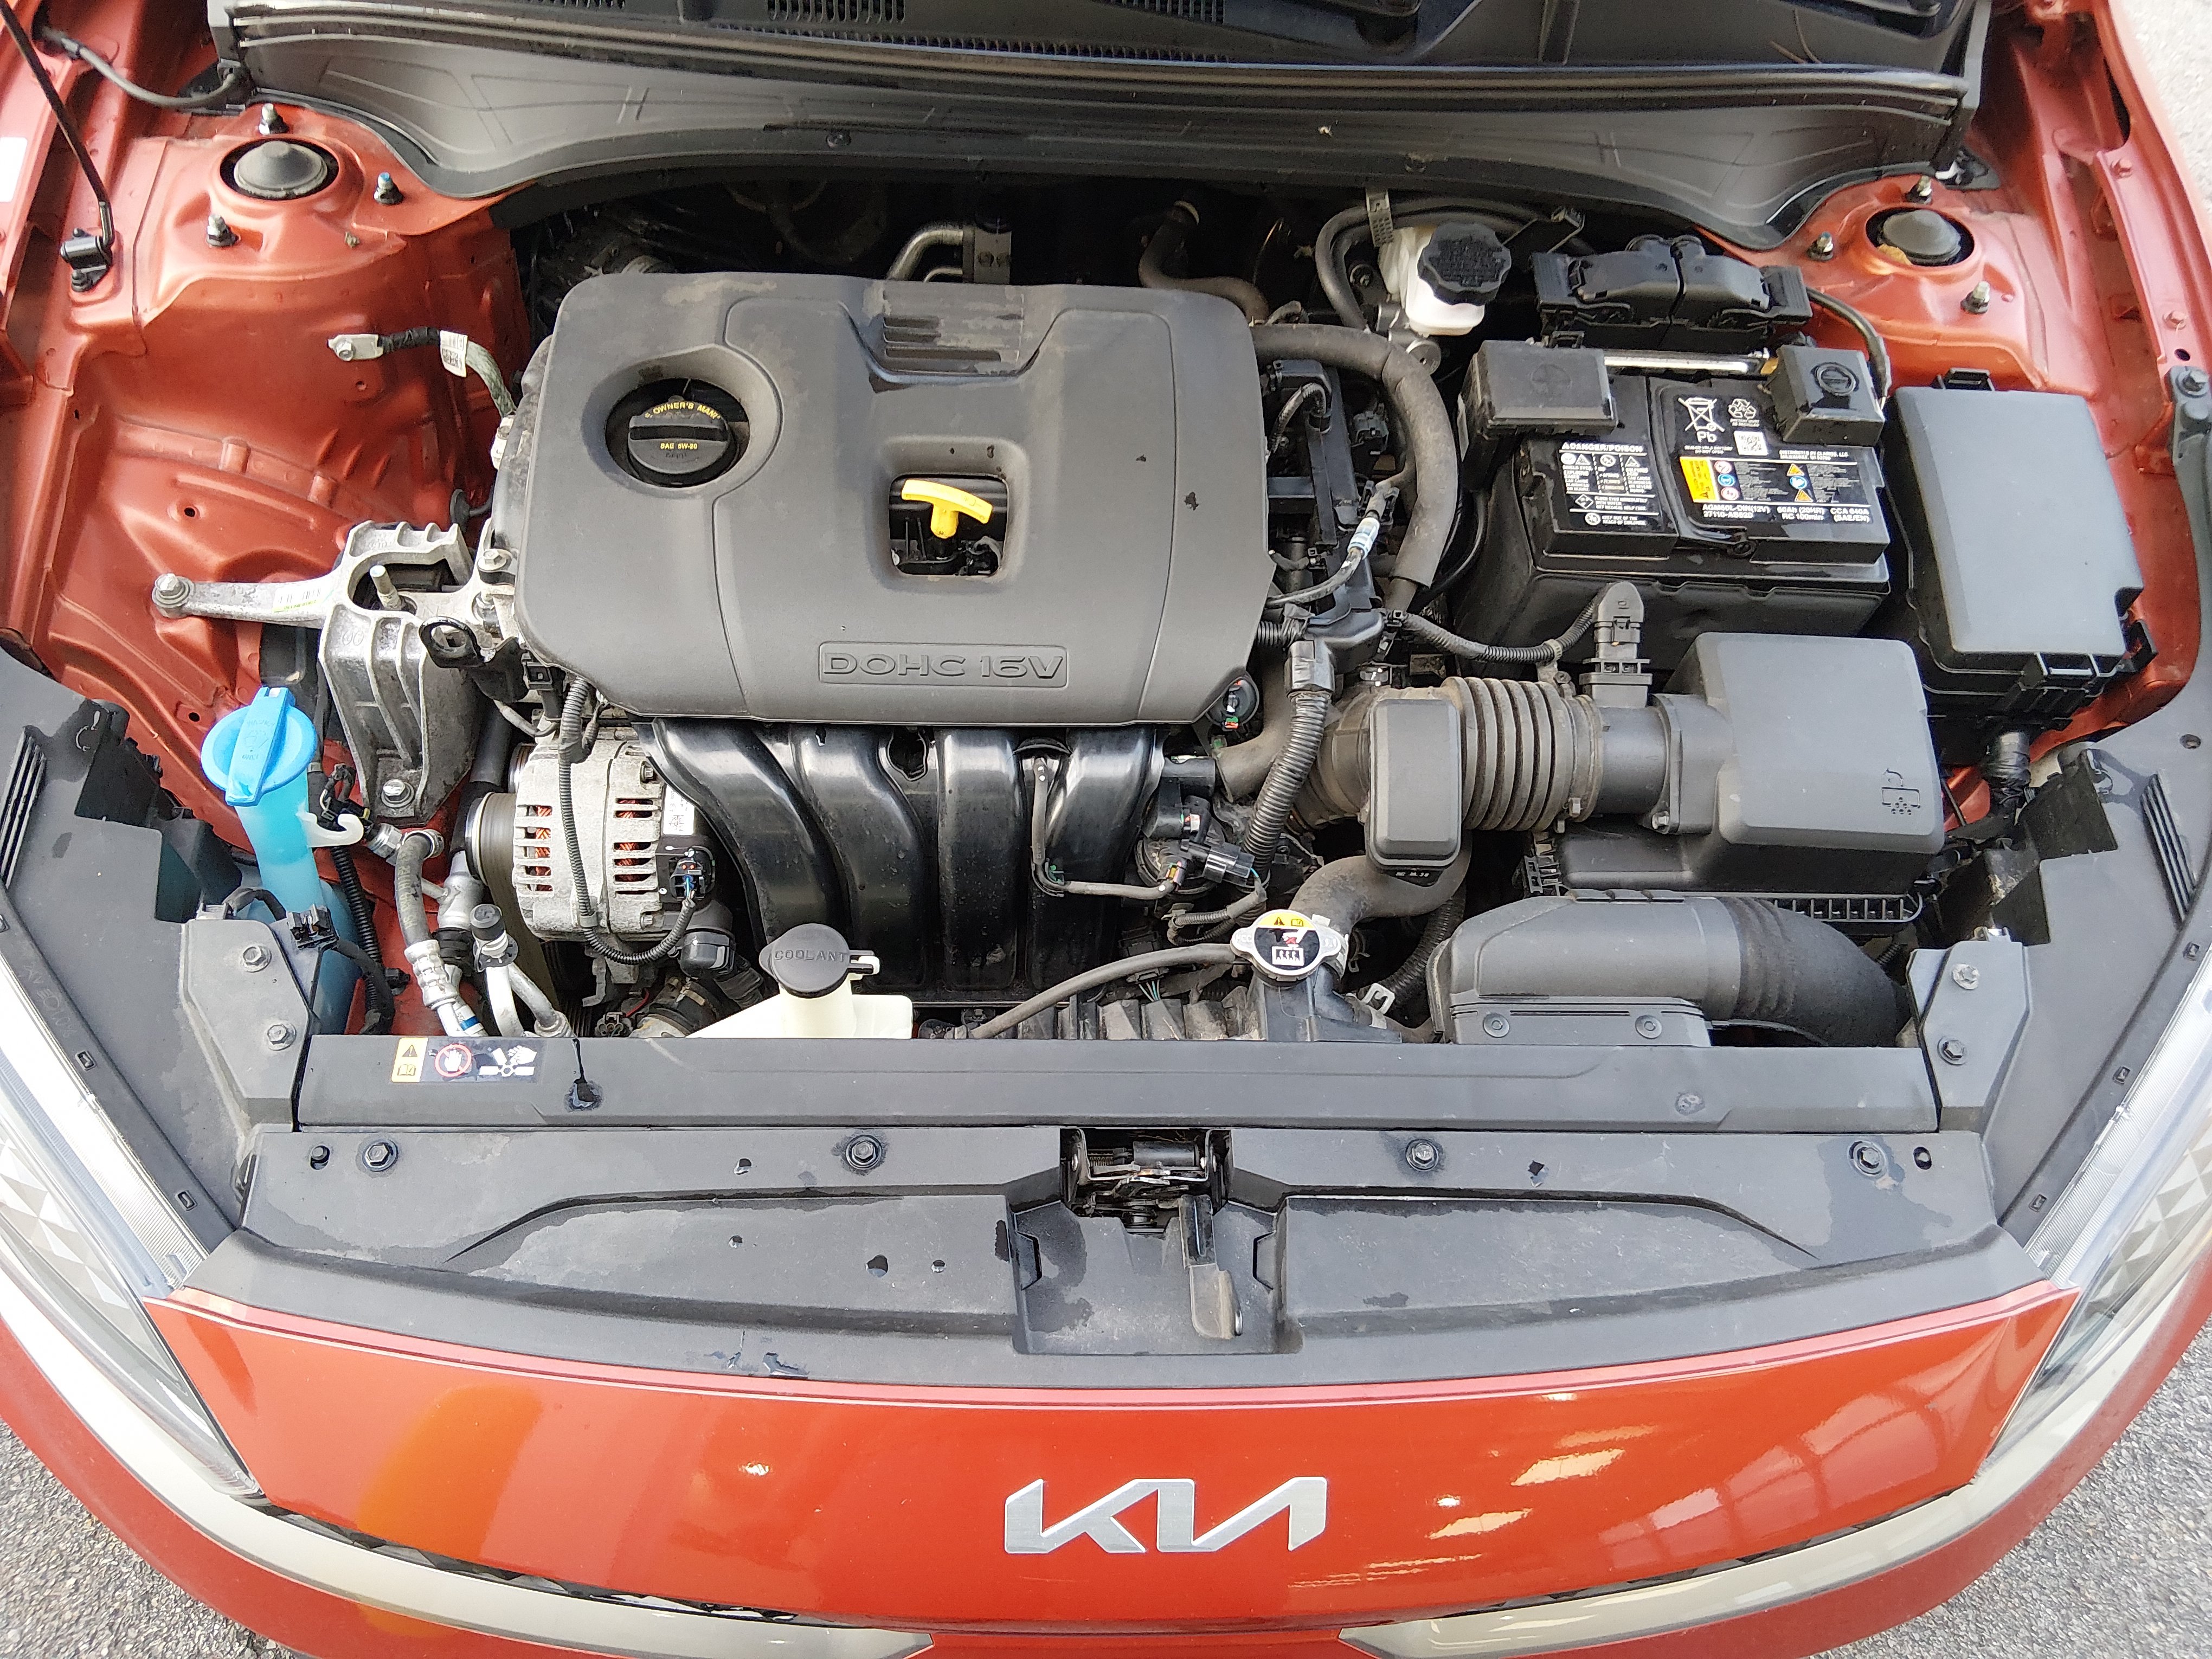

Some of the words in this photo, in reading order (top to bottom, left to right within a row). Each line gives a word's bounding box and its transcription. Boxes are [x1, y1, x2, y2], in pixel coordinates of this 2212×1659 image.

[653, 402, 695, 415] OWNER'S
[1696, 431, 1717, 443] Pb
[824, 652, 966, 677] DOHC
[980, 655, 1064, 679] 16V
[774, 949, 850, 963] COOLANT
[1005, 1476, 1327, 1554] KIA
